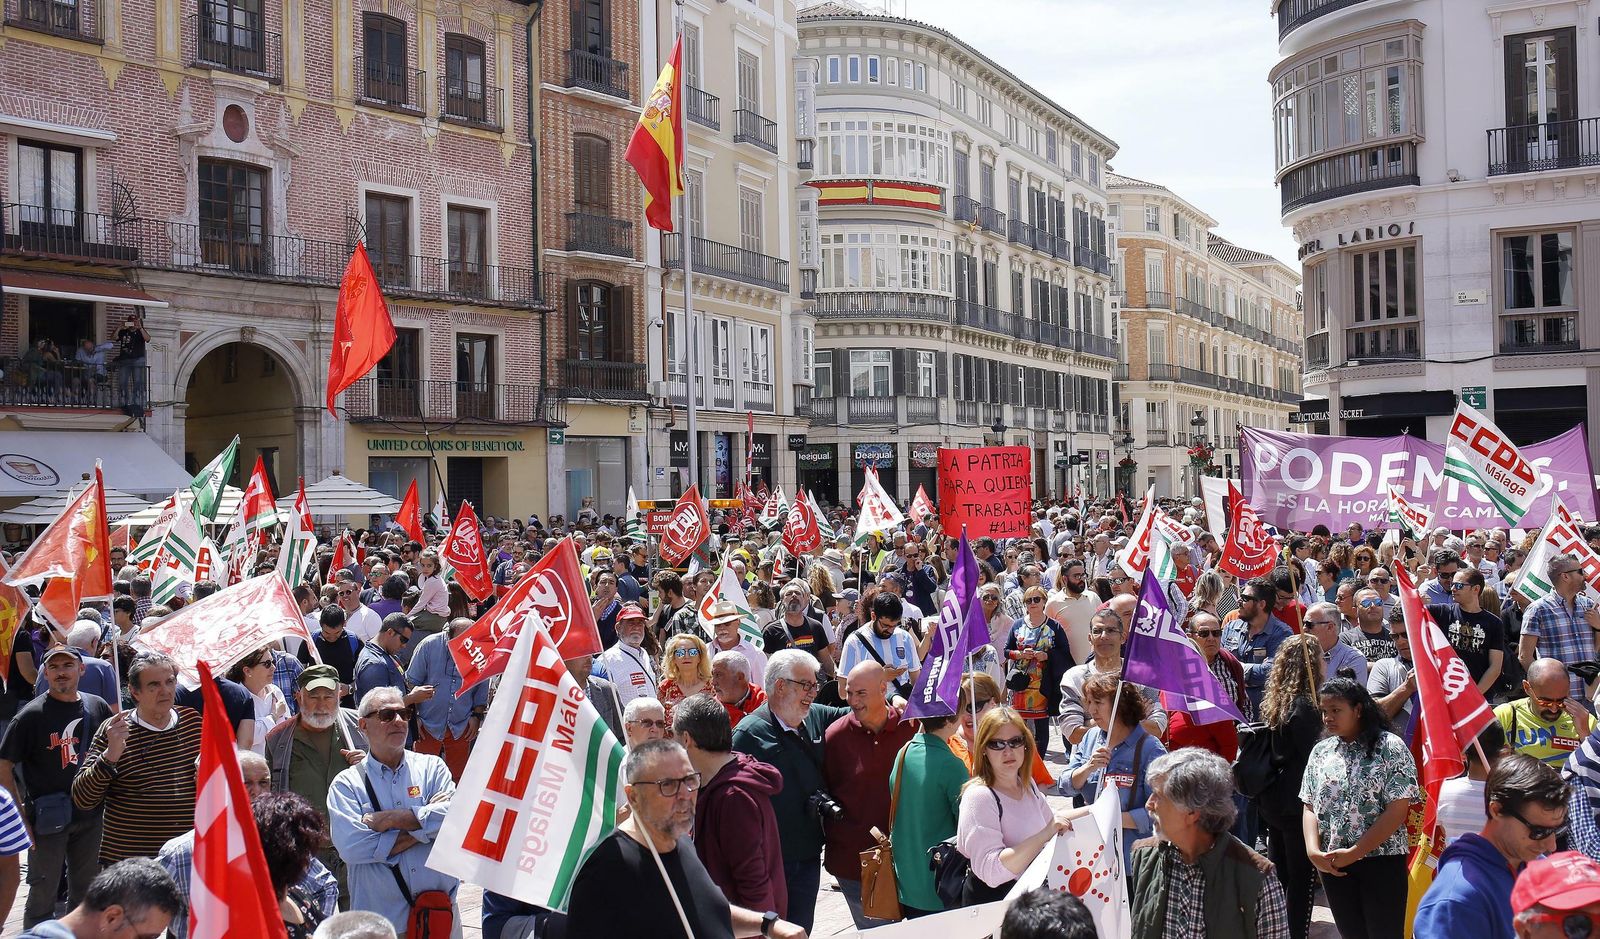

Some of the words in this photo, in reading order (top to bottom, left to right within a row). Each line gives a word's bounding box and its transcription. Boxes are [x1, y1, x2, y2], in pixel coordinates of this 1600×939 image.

[1338, 222, 1414, 245] LARIOS
[1297, 411, 1330, 421] VICTORIA'S
[1340, 409, 1364, 418] SECRET
[367, 439, 408, 451] UNITED
[411, 440, 453, 451] COLORS
[456, 440, 471, 451] OF
[855, 451, 892, 460] Desigual
[942, 456, 959, 472] LA
[967, 453, 1023, 471] PATRIA
[1254, 442, 1567, 503] PODEMS.
[1485, 463, 1527, 496] Málaga
[943, 478, 976, 494] PARA
[984, 475, 1028, 493] QUIEN
[945, 504, 959, 517] LA
[962, 501, 1028, 517] TRABAJA
[1276, 492, 1298, 509] ES
[1304, 497, 1330, 513] LA
[1338, 499, 1390, 514] HORA
[923, 656, 943, 704] Málaga
[551, 685, 586, 753] Mála
